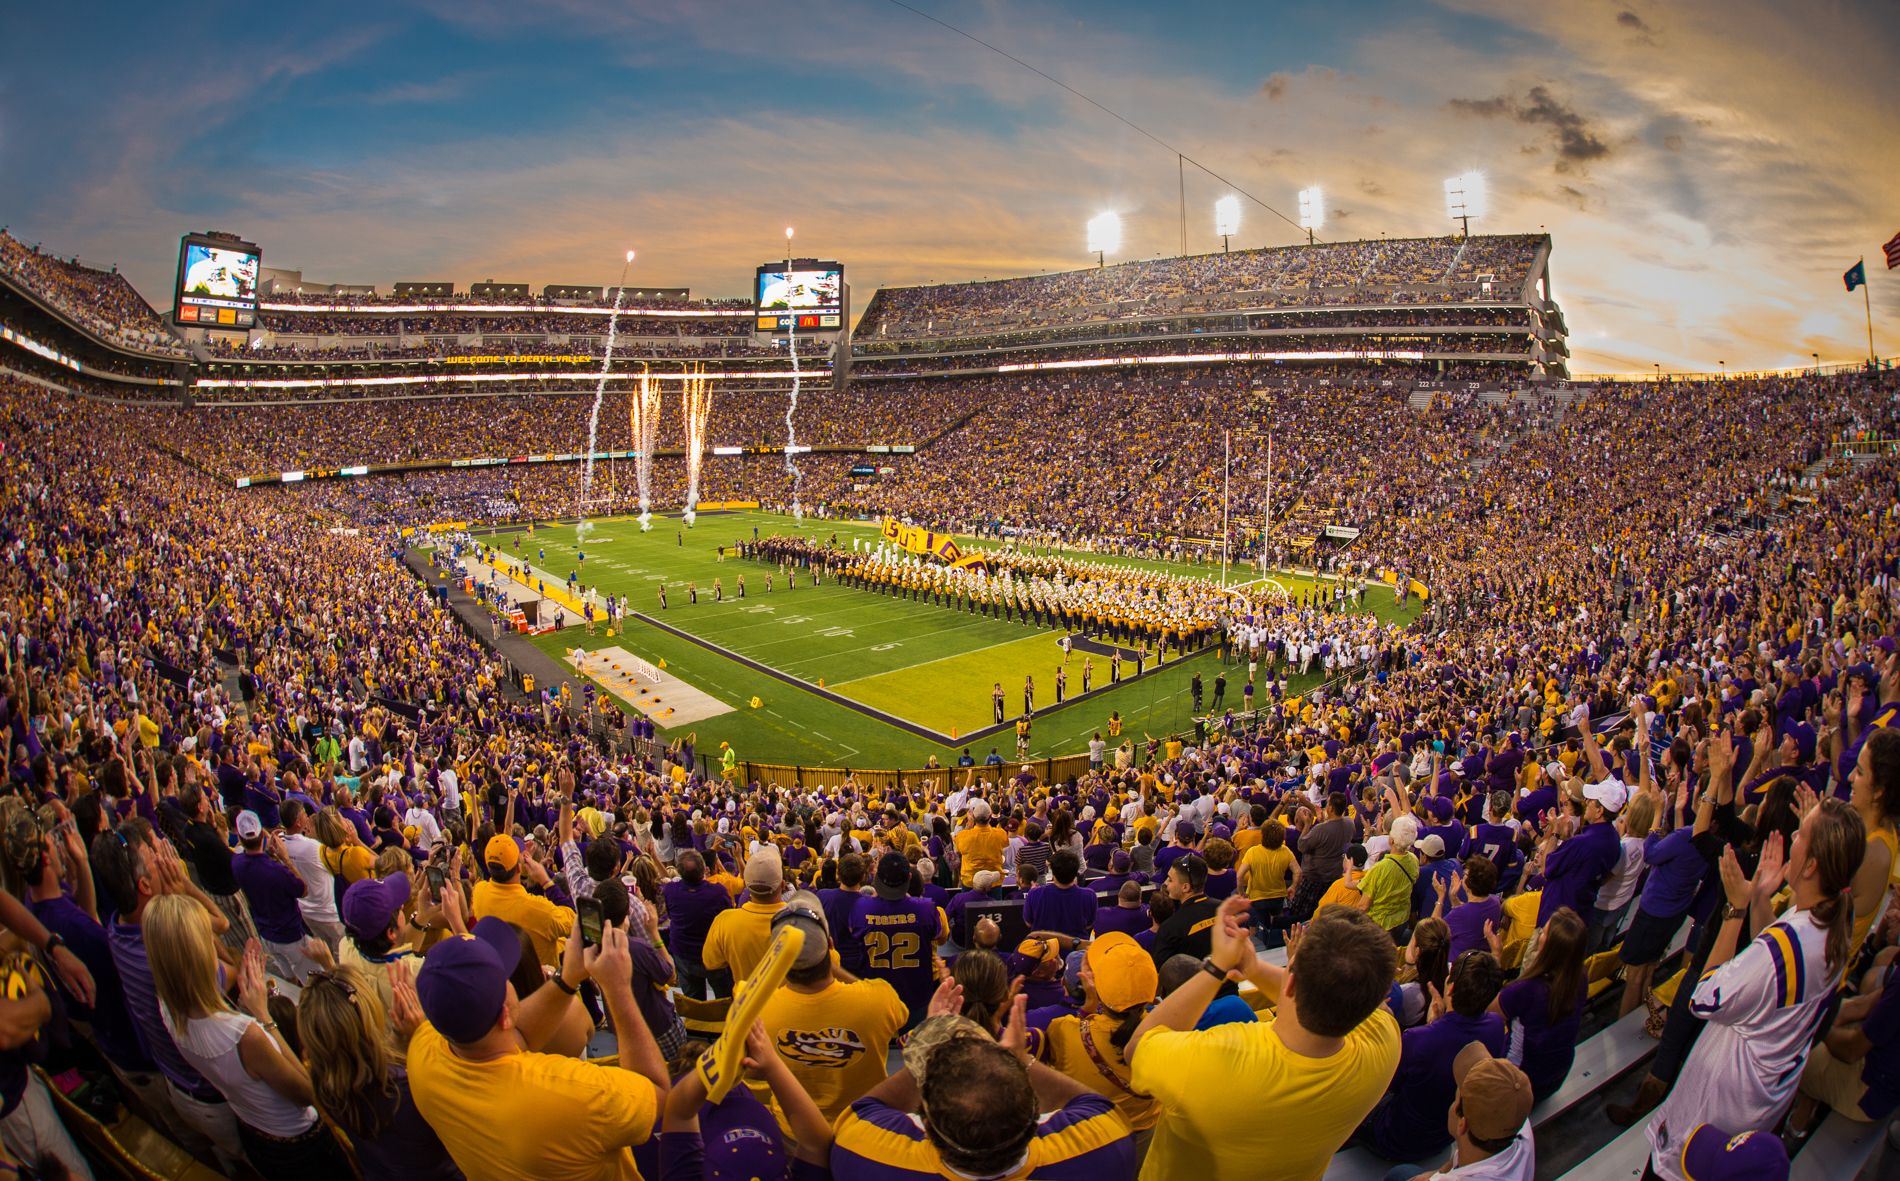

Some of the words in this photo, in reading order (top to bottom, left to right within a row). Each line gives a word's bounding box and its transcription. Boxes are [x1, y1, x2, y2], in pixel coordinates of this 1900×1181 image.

[447, 355, 500, 364] WELCOME
[504, 355, 517, 363] TO
[520, 355, 552, 363] DEATH
[556, 355, 591, 363] VALLEY
[1483, 843, 1500, 862] 7
[865, 913, 917, 925] TIGERS
[864, 931, 920, 970] 22
